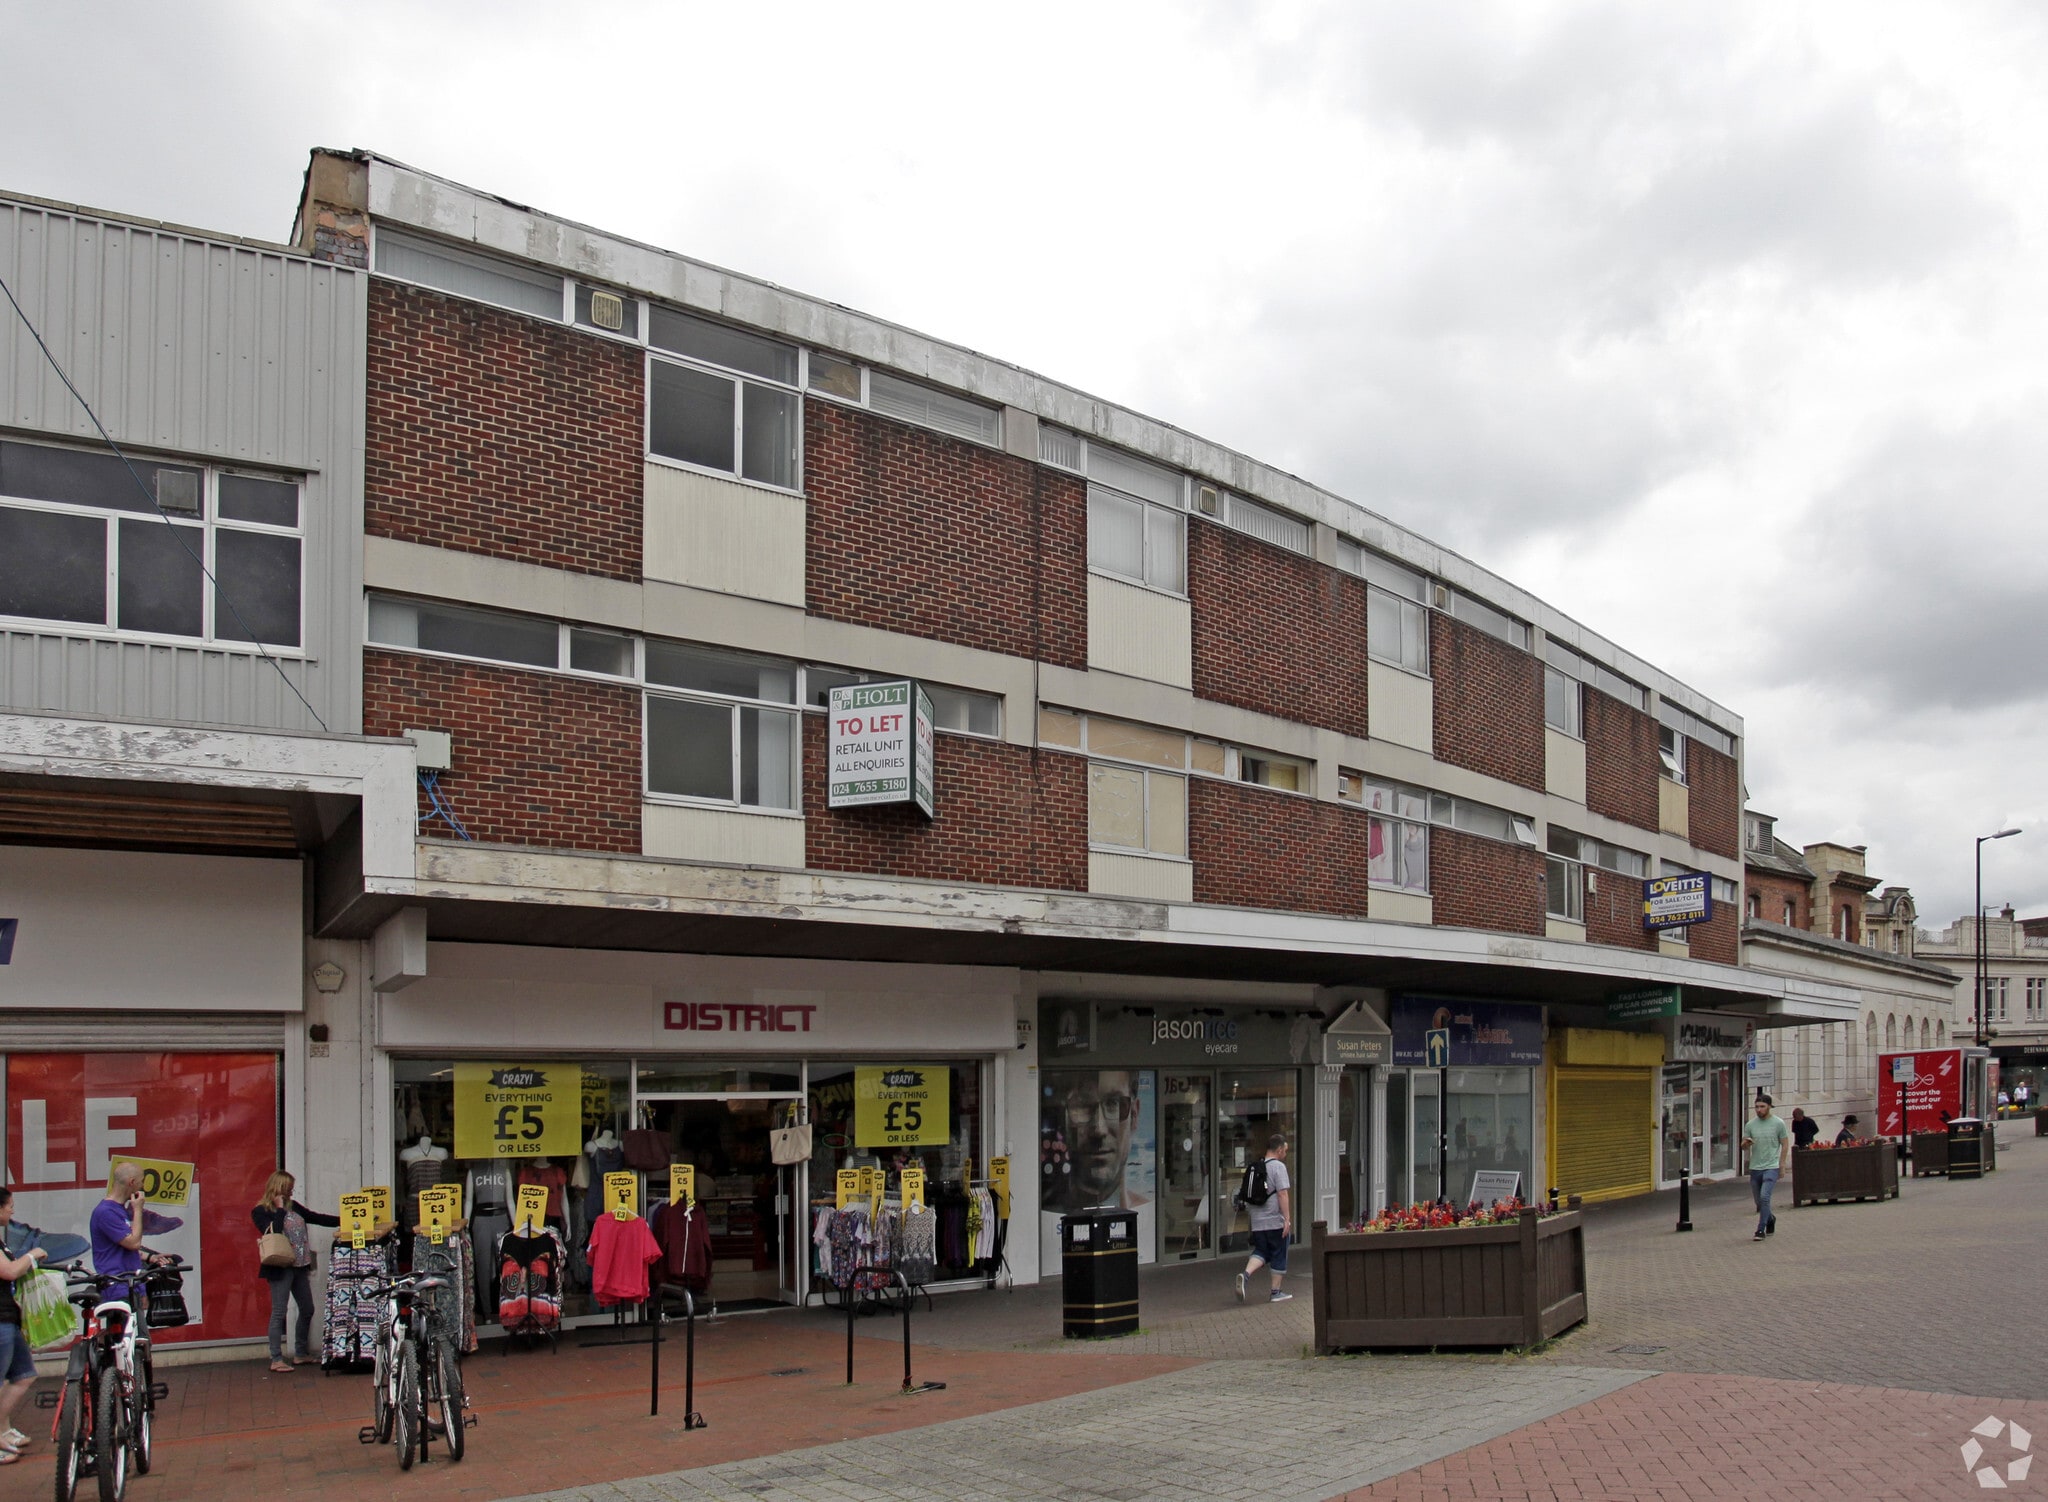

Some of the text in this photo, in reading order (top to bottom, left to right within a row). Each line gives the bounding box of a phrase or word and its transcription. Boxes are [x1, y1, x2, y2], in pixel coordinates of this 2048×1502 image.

[856, 688, 905, 706] HOLT
[836, 714, 903, 736] TO LET
[836, 740, 904, 755] RETAIL UNIT
[835, 758, 904, 772] ALL ENQUIRIES
[833, 779, 906, 795] 024 7655 5180
[1650, 877, 1704, 894] LOVEITTS
[1668, 912, 1686, 922] 7622
[1688, 911, 1705, 919] 8111
[1638, 989, 1662, 998] LOANS
[1625, 1000, 1640, 1009] CAR
[1641, 996, 1673, 1007] OWNERS
[664, 1002, 816, 1032] DISTRICT
[1205, 1043, 1238, 1056] eyecare
[1337, 1040, 1382, 1050] Susan Peters
[502, 1074, 534, 1085] CRAZY!
[890, 1074, 913, 1085] CRAZY!
[485, 1093, 552, 1102] EVERYTHING
[884, 1101, 922, 1131] £5
[494, 1105, 544, 1140] £5
[7, 1098, 137, 1184] LE
[499, 1144, 541, 1153] OR LESS
[142, 1168, 187, 1198] 0%
[476, 1175, 505, 1186] CHIC
[160, 1191, 185, 1200] OFF!
[373, 1200, 384, 1208] £3
[431, 1205, 444, 1213] £3
[526, 1200, 538, 1209] £5
[352, 1209, 366, 1217] £3
